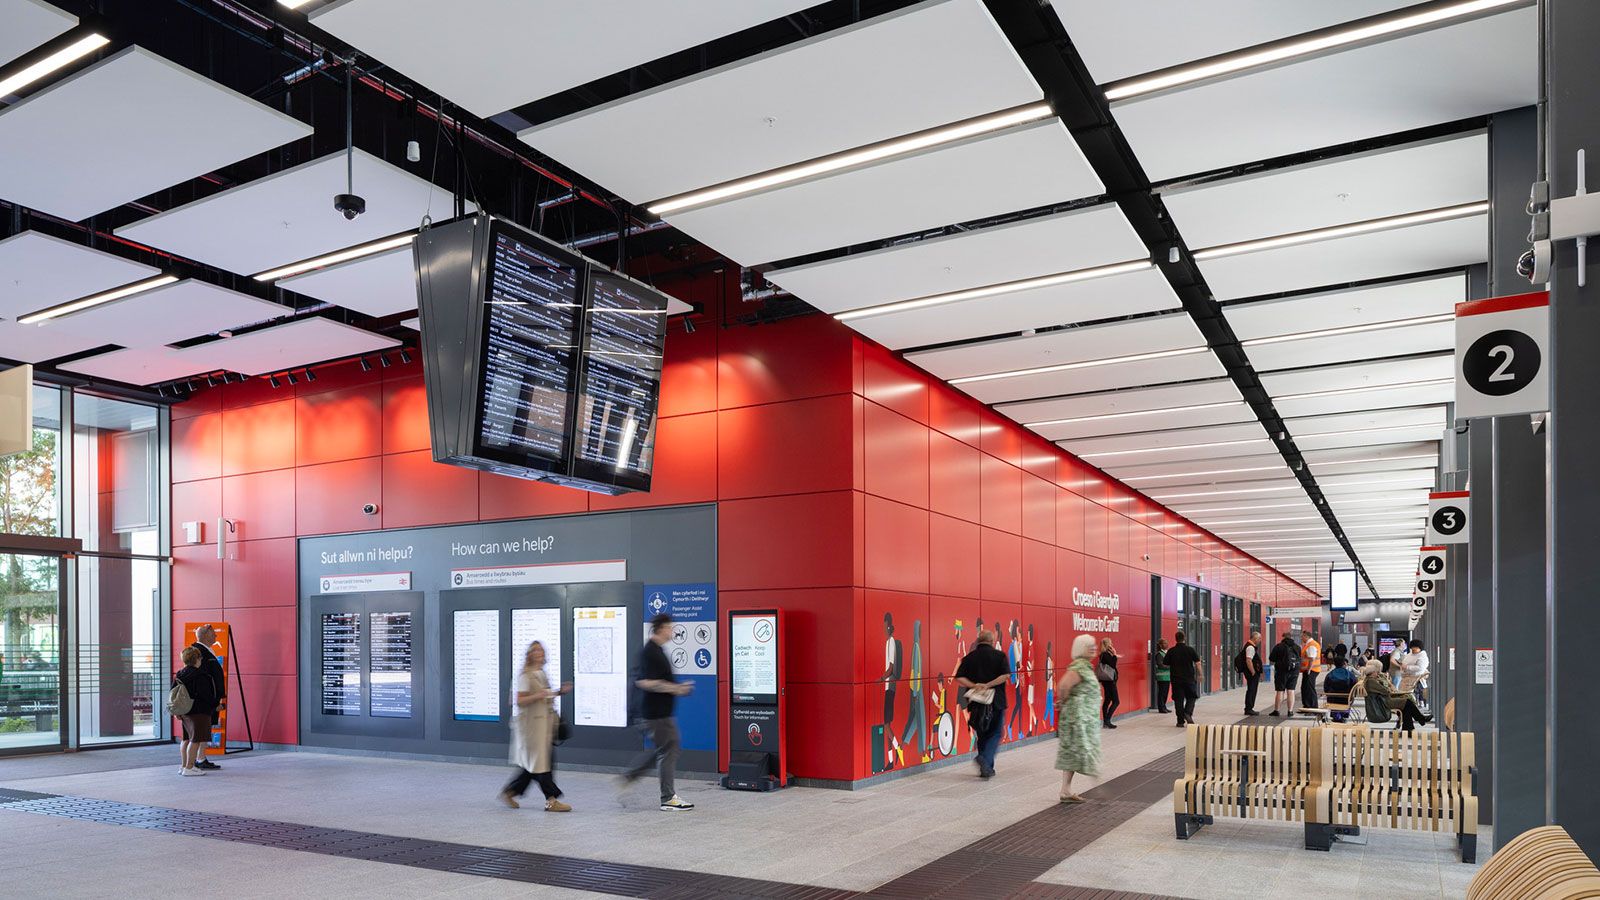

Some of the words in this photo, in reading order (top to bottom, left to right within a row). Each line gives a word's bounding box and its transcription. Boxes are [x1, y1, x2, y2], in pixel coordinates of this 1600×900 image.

[1488, 345, 1515, 382] 2
[1442, 512, 1456, 528] 3
[321, 551, 336, 564] Sut
[339, 550, 364, 563] allwn
[367, 548, 376, 561] ni
[379, 545, 413, 563] helpu?
[452, 542, 477, 556] How
[479, 542, 500, 555] can
[502, 542, 520, 552] we
[522, 536, 554, 554] help?
[1428, 559, 1437, 570] 4
[1422, 582, 1428, 590] 5
[1073, 587, 1093, 607] Croeso
[1093, 590, 1095, 607] i
[1073, 613, 1098, 632] Welcome
[1098, 616, 1103, 632] to
